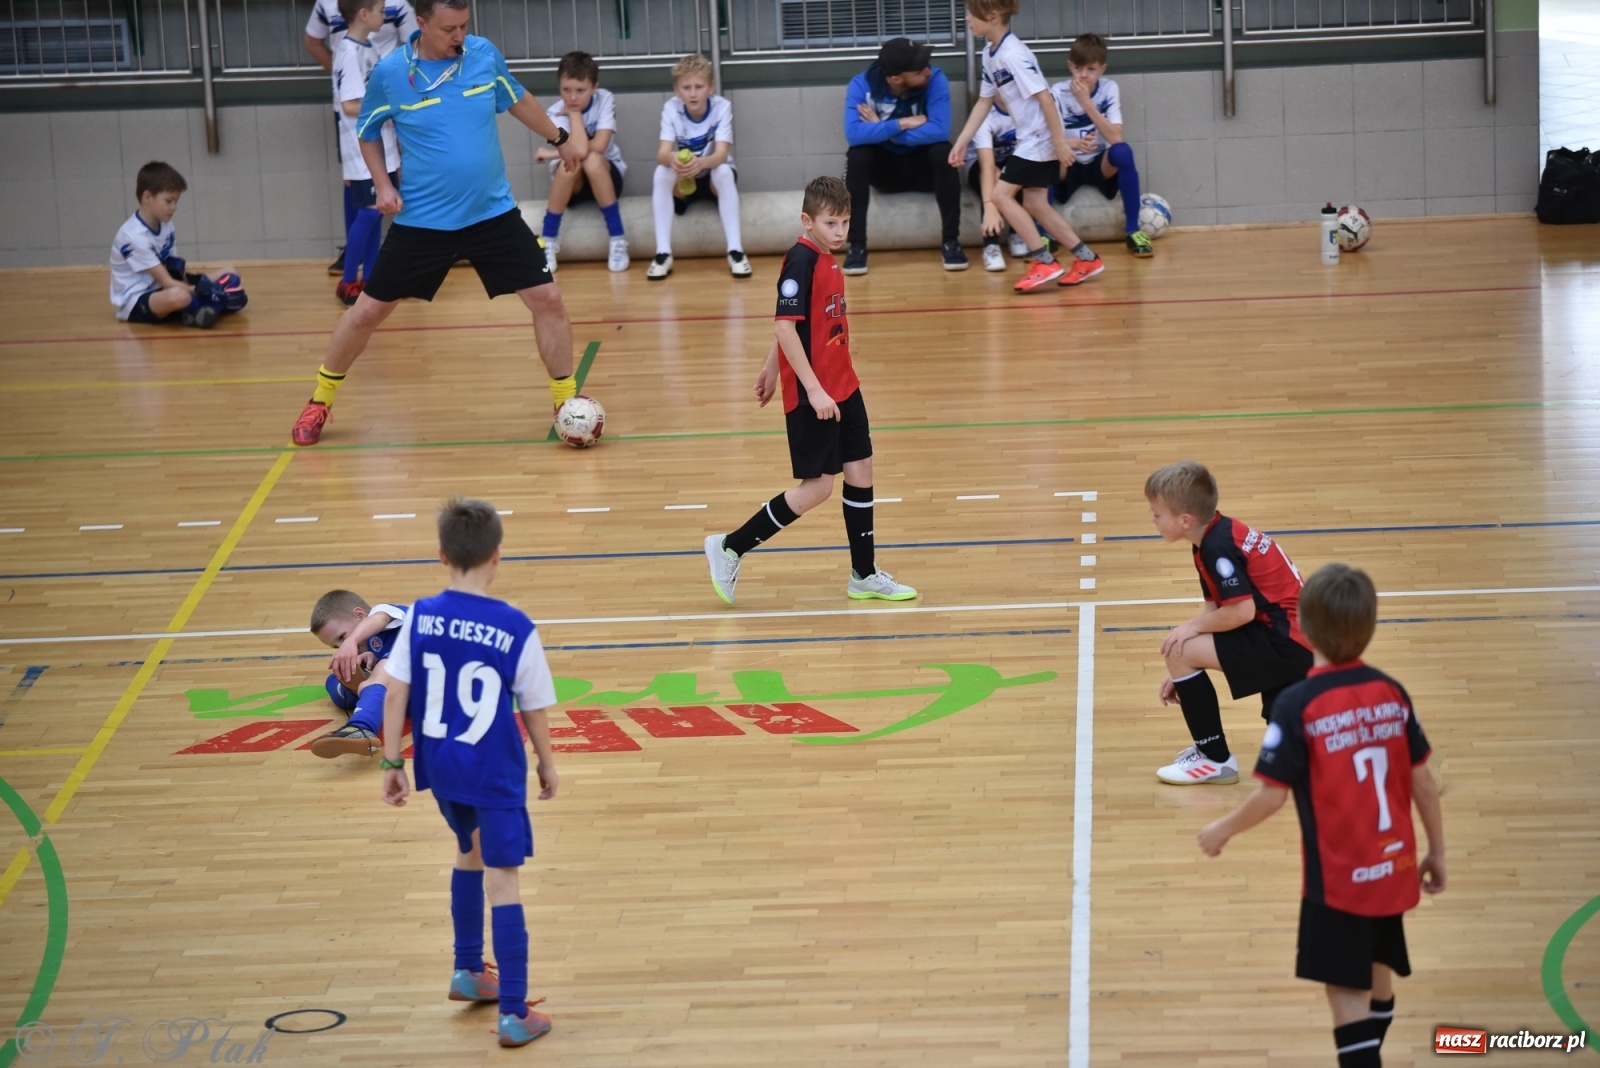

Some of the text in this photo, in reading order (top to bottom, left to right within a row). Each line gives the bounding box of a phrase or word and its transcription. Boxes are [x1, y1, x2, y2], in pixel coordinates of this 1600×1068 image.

[417, 614, 514, 654] UKS CIESZYN
[421, 652, 502, 746] 19
[1352, 746, 1393, 832] 7
